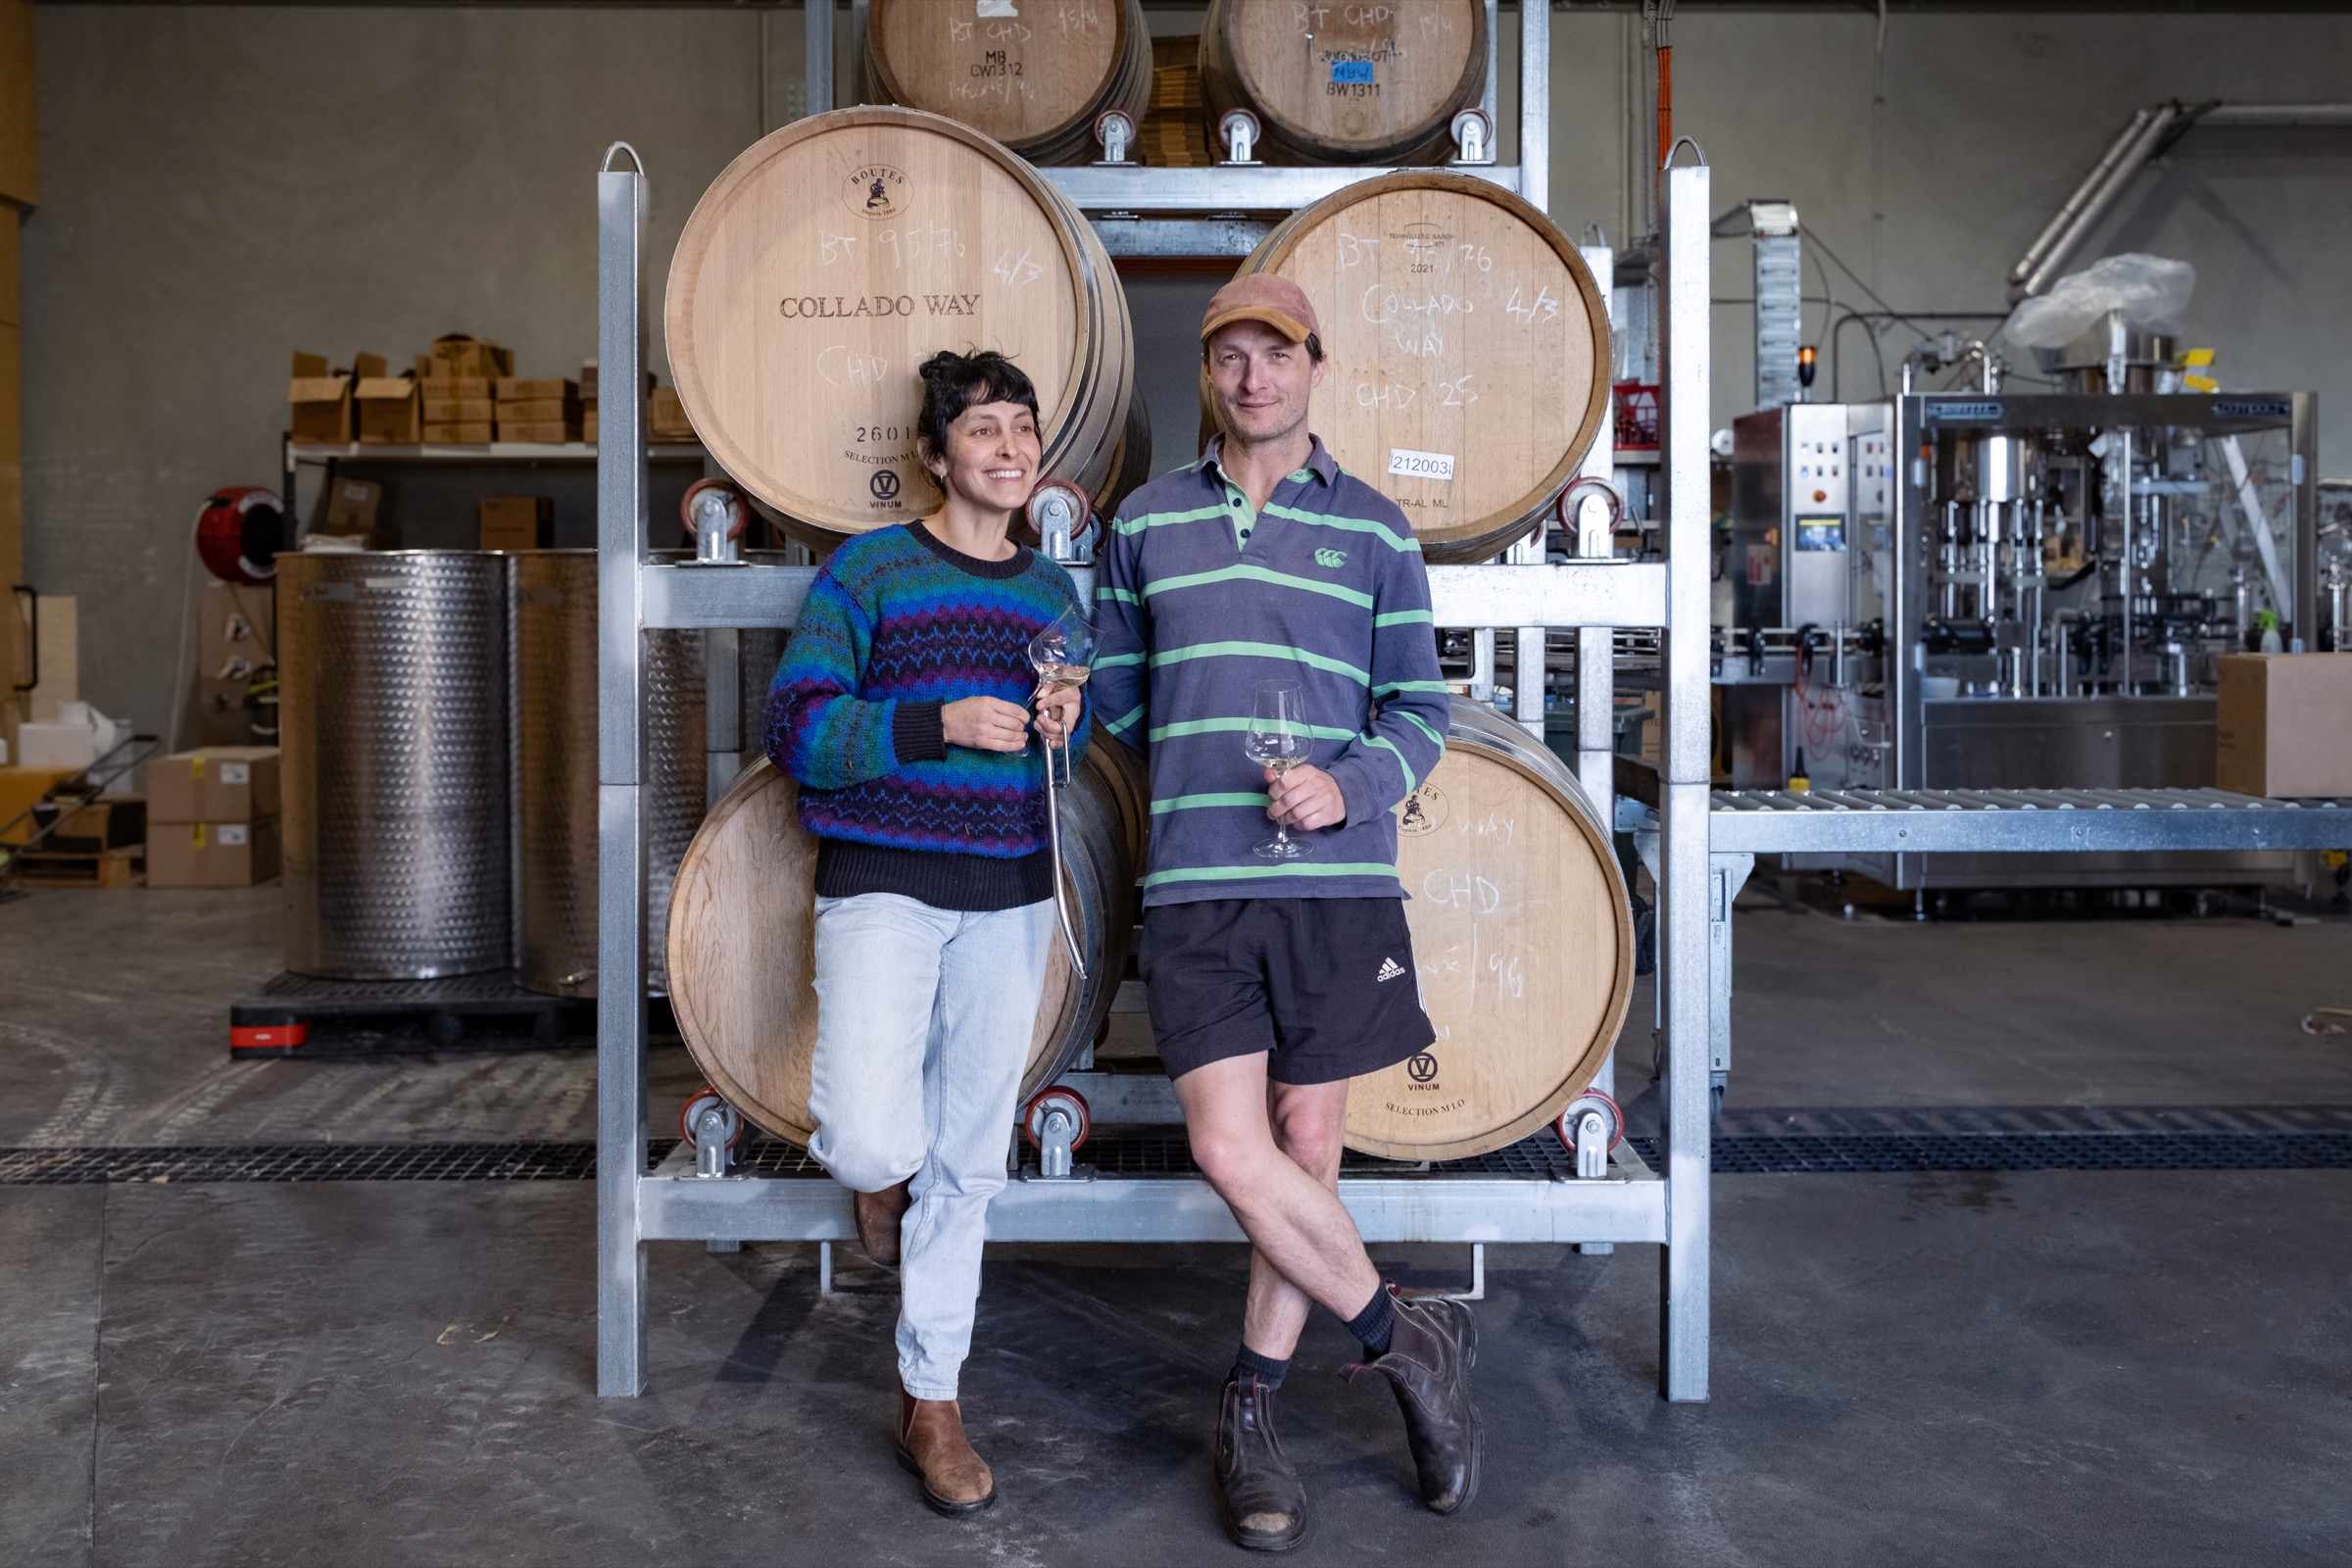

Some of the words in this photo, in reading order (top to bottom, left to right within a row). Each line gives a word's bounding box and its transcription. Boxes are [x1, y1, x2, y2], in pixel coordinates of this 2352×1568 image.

[986, 50, 1006, 64] MB
[851, 168, 905, 186] BOUTES
[1410, 264, 1435, 273] 2021
[779, 295, 915, 318] COLLADO
[923, 294, 981, 316] WAY
[816, 345, 889, 386] CHD
[844, 449, 898, 466] SELECTION
[1433, 499, 1448, 509] ML
[1424, 868, 1499, 914] CHD
[1377, 966, 1406, 983] adidas
[1385, 1102, 1439, 1117] SELECTION
